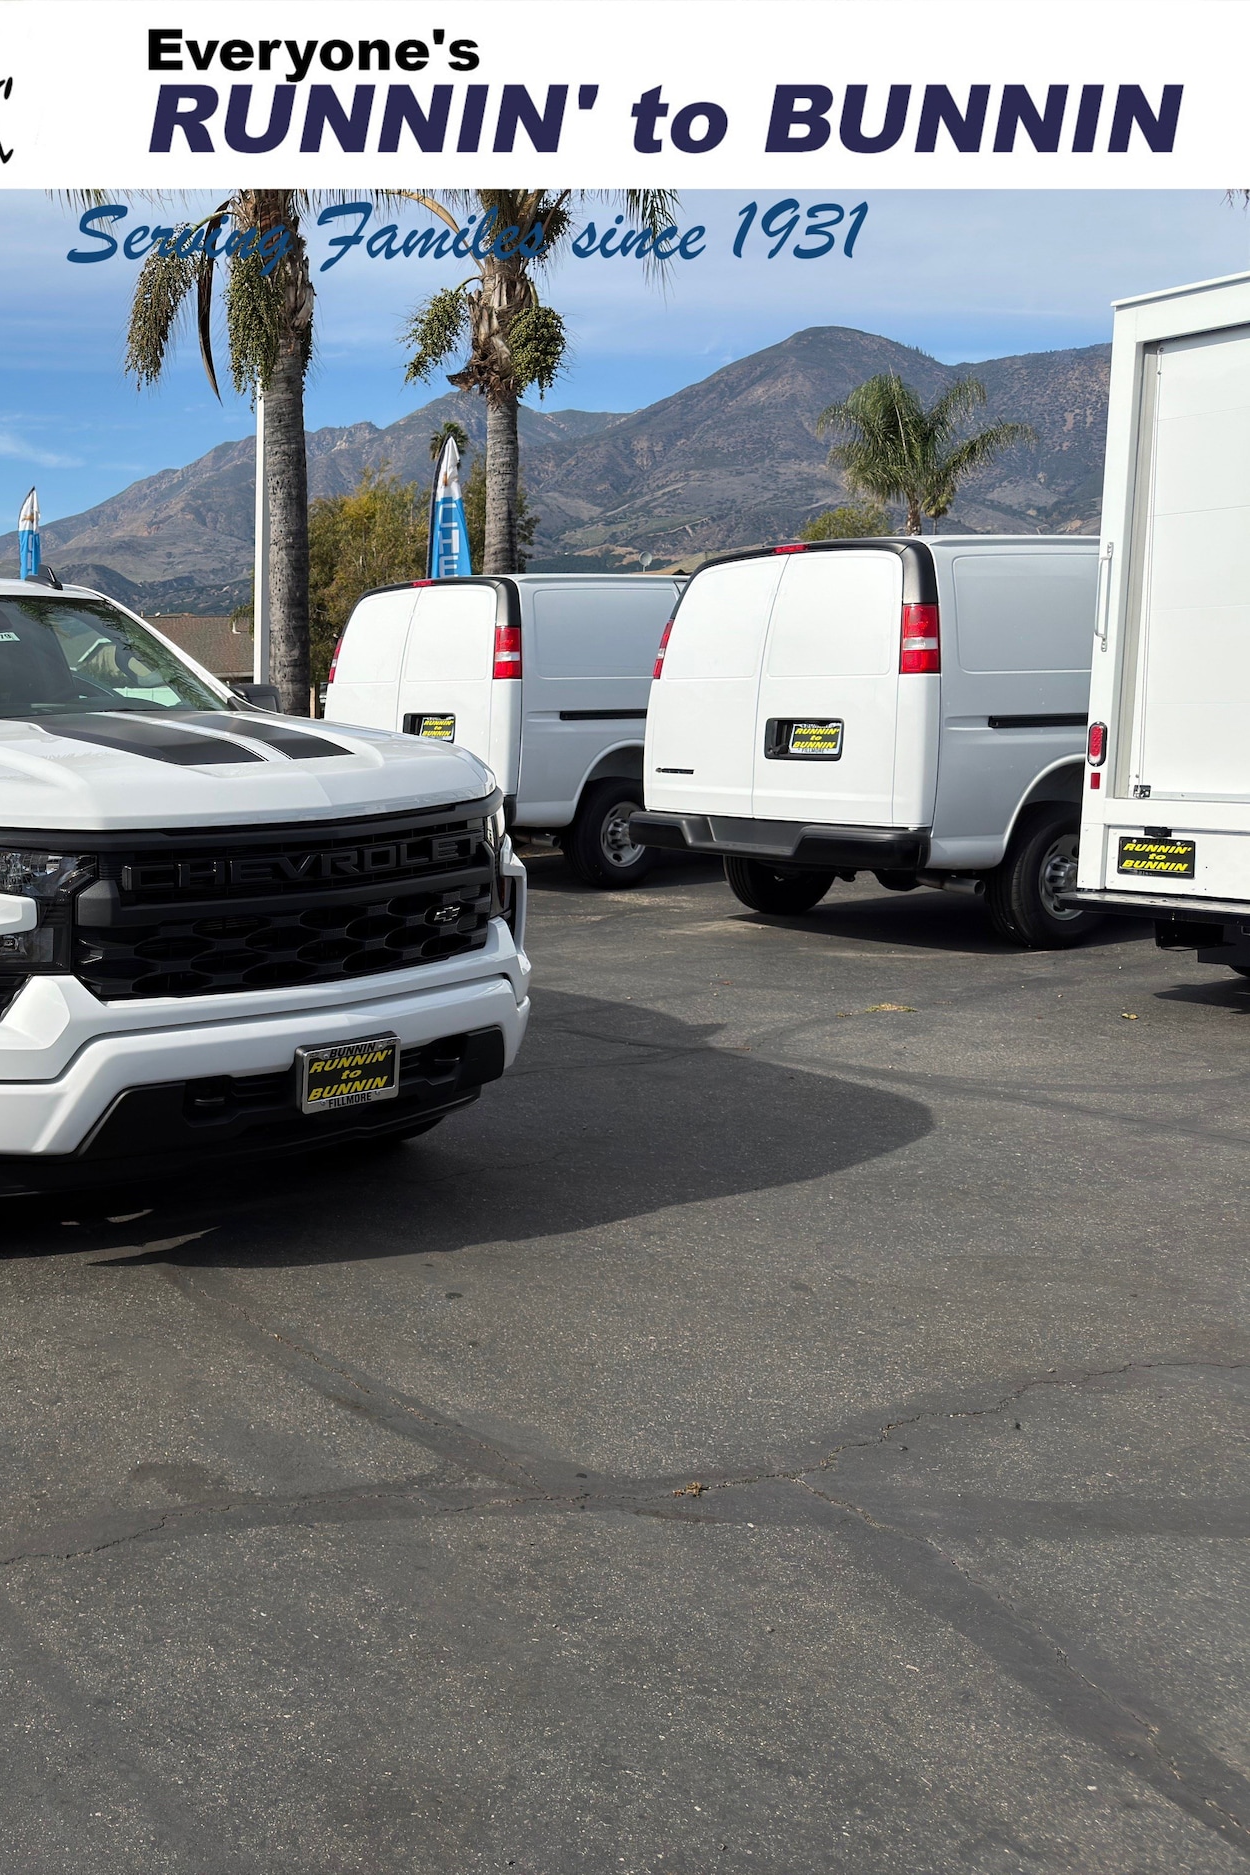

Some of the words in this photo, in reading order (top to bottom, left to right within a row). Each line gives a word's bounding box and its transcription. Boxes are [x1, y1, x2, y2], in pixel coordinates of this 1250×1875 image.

[792, 741, 836, 749] BUNNIN
[1123, 843, 1193, 854] RUNNIN'
[122, 828, 485, 892] CHEVROLET
[1122, 859, 1189, 872] BUNNIN
[329, 1042, 376, 1058] BUNNIN
[309, 1049, 393, 1074] RUNNIN'
[340, 1069, 363, 1080] to
[307, 1075, 389, 1102] BUNNIN
[328, 1092, 372, 1109] FILLMORE
